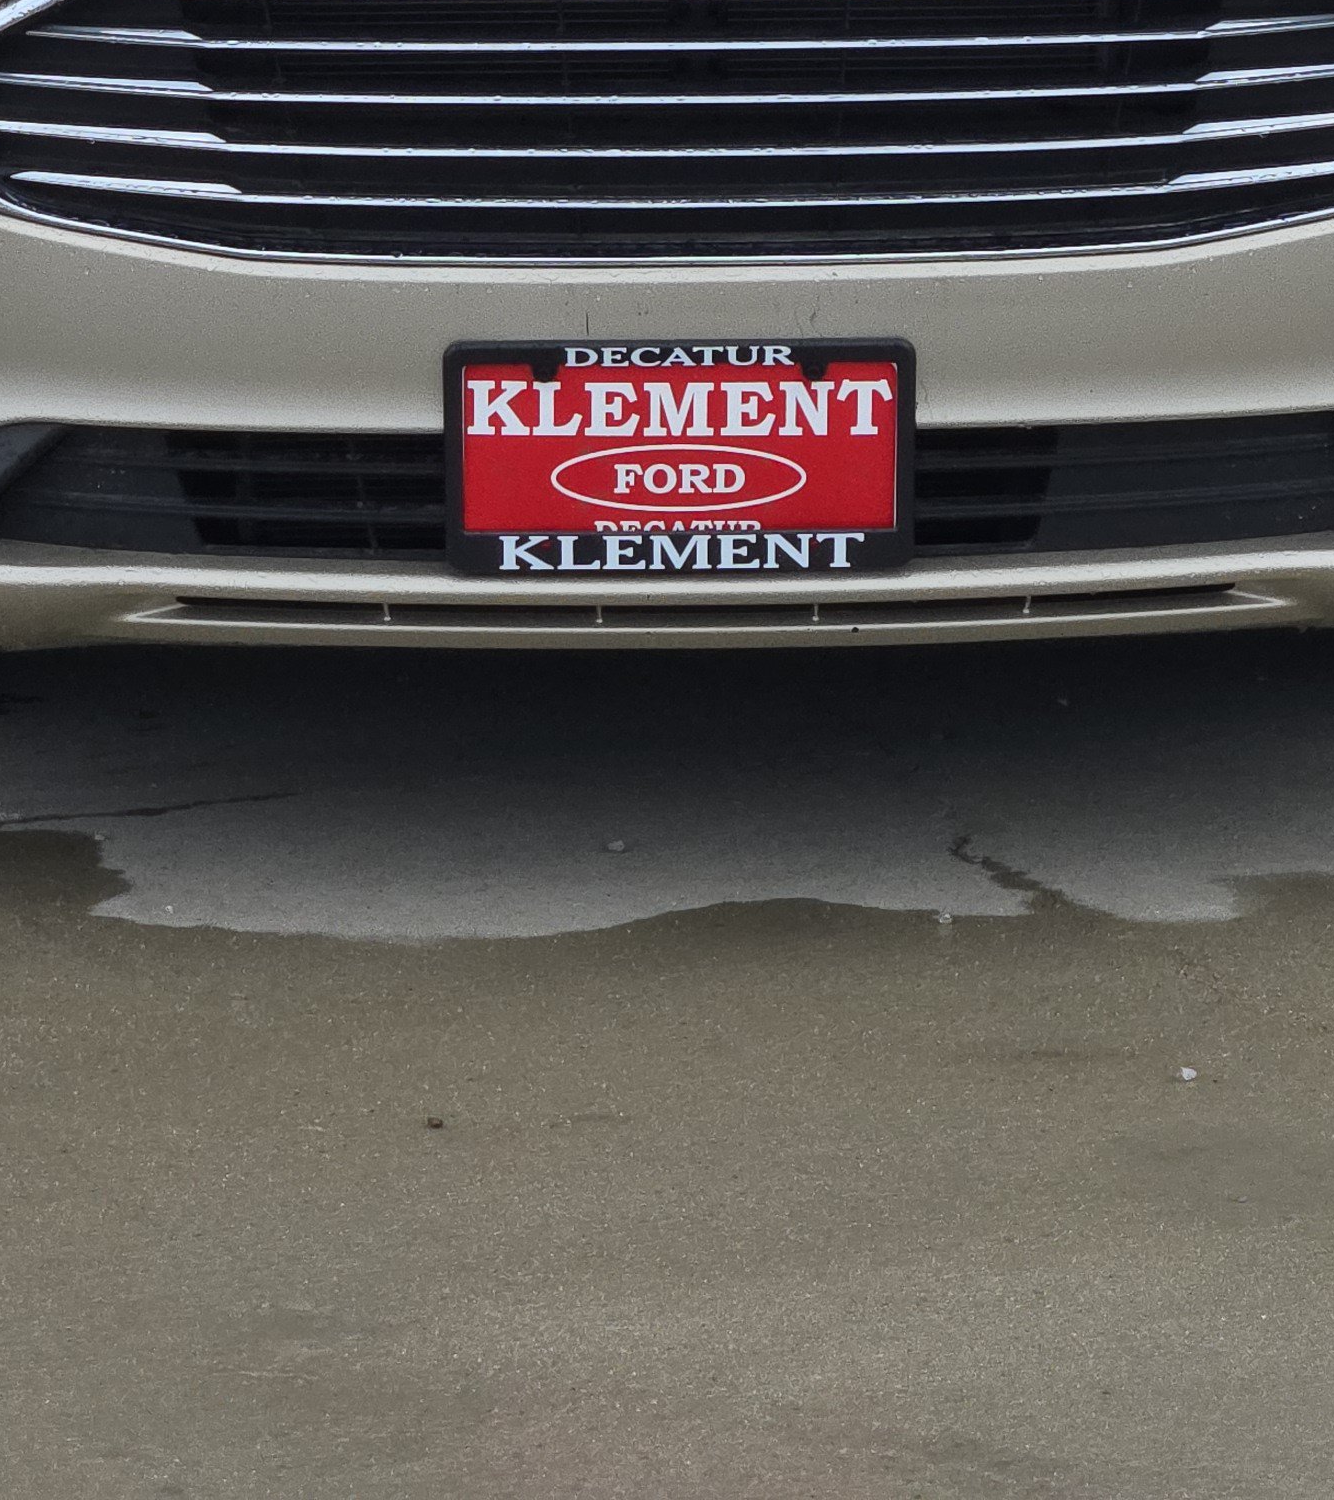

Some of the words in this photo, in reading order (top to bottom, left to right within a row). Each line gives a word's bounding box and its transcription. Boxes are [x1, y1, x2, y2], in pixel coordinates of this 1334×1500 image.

[564, 345, 794, 367] DECATUR
[467, 378, 893, 437] KLEMENT
[614, 463, 745, 494] FORD
[499, 533, 865, 570] KLEMENT
